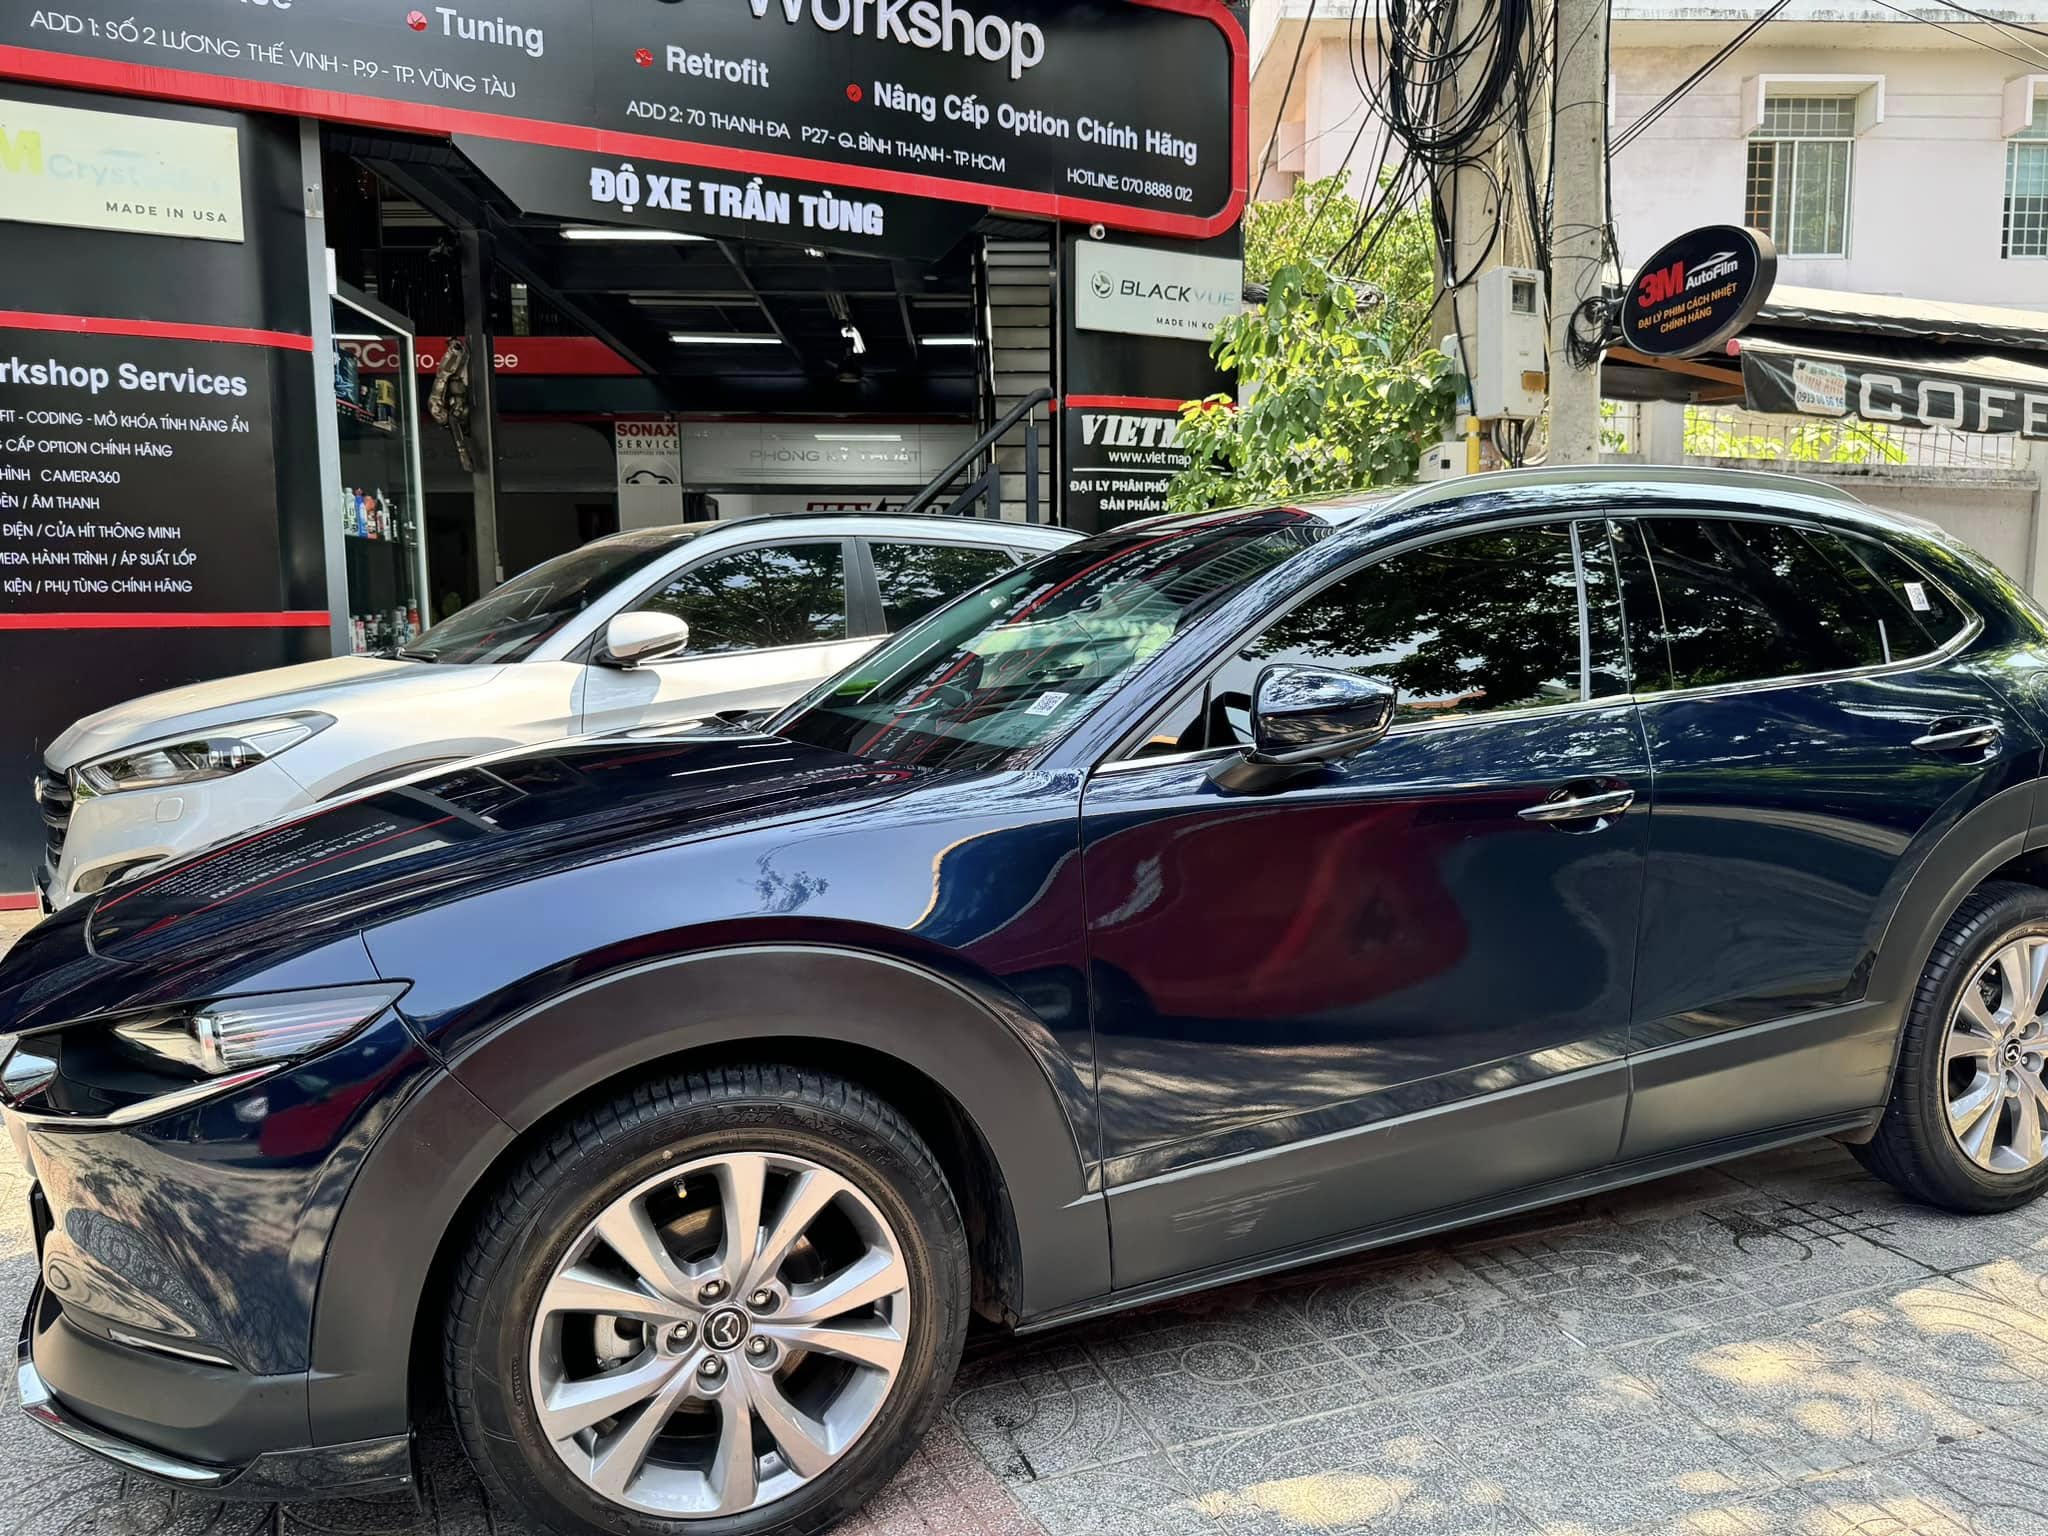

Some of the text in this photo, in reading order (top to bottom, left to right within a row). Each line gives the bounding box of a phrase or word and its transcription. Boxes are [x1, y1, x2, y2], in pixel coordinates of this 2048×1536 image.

[435, 6, 544, 58] Tuning
[30, 10, 83, 34] ADD
[106, 17, 139, 42] SỐ
[142, 27, 156, 46] 2
[162, 29, 241, 58] LƯƠNG
[247, 41, 285, 65] THẾ
[289, 49, 338, 73] VINH
[418, 68, 477, 93] VŨNG
[481, 74, 516, 98] TÀU
[666, 44, 769, 88] Retrofit
[873, 80, 1198, 166] Nâng Cấp Option Chính Hãng
[626, 100, 666, 121] ADD
[669, 106, 683, 123] 2:
[686, 109, 706, 127] 70
[709, 112, 764, 136] THANH
[766, 121, 791, 140] ĐA
[859, 131, 891, 156] BÌNH
[971, 155, 1006, 173] HCM
[590, 162, 884, 236] ĐỘ XE TRẦN TÙNG
[1121, 177, 1143, 195] 070
[1144, 181, 1173, 199] 8888
[1174, 185, 1193, 202] 012
[106, 201, 228, 223] MADE IN USA
[1120, 279, 1235, 306] BLACKVUE
[1638, 260, 1738, 308] 3M AutoFilm
[1663, 303, 1686, 319] PHIM
[1686, 294, 1710, 310] CÁCH
[1711, 282, 1738, 301] NHIỆT
[1156, 317, 1184, 327] MADE
[118, 362, 248, 397] Services
[26, 410, 83, 426] CODING
[93, 410, 119, 427] MỞ
[121, 412, 158, 430] KHÓA
[160, 414, 187, 431] TÍNH
[189, 416, 228, 432] NĂNG
[231, 414, 250, 433] ẨN
[617, 423, 677, 437] SONAX
[1081, 414, 1185, 449] VIETM
[5, 435, 35, 452] CẤP
[38, 439, 88, 454] OPTION
[90, 439, 131, 456] CHÍNH
[134, 441, 173, 457] HÃNG
[617, 440, 679, 449] SERVICE
[40, 469, 120, 484] CAMERA360
[1070, 480, 1092, 494] ĐẠI
[1112, 478, 1144, 492] PHÂN
[0, 491, 19, 508] ÈN
[31, 493, 53, 509] ÂM
[56, 496, 100, 510] THANH
[3, 520, 33, 540] ĐIỆN
[44, 520, 76, 538] CỬA
[78, 522, 96, 538] HÍT
[99, 522, 145, 538] THÔNG
[148, 526, 181, 539] MINH
[32, 548, 70, 565] HÀNH
[72, 550, 108, 565] TRÌNH
[120, 550, 138, 566] ÁP
[140, 548, 171, 566] SUẤT
[172, 547, 197, 566] LỐP
[4, 577, 33, 596] KIỆN
[44, 580, 70, 596] PHỤ
[73, 577, 109, 593] TÙNG
[111, 577, 151, 593] CHÍNH
[154, 577, 193, 593] HÃNG
